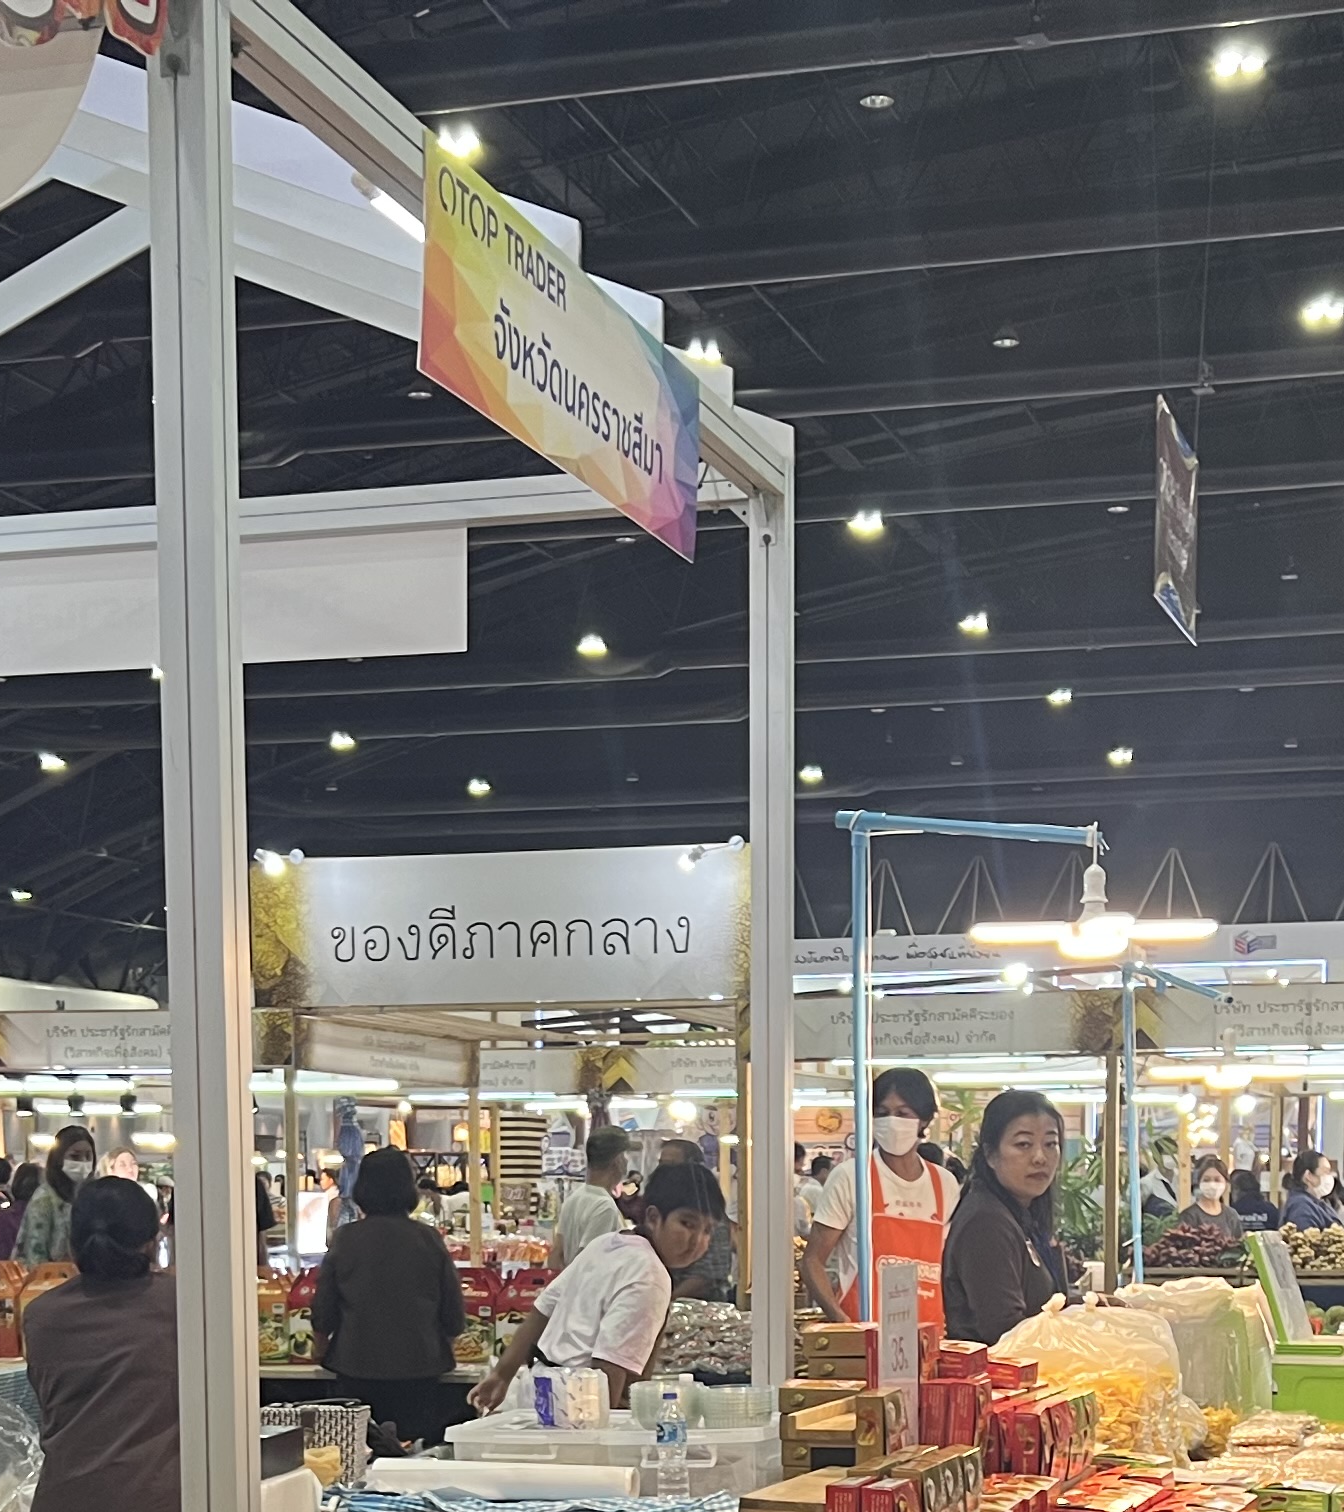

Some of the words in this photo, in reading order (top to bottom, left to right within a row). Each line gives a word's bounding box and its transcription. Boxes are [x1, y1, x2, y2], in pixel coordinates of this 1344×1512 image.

[437, 164, 498, 249] OTOP
[503, 222, 568, 313] TRADER
[493, 298, 665, 486] จังหวัดนครราชสีมา
[331, 904, 691, 963] ของดีภาคกลาง
